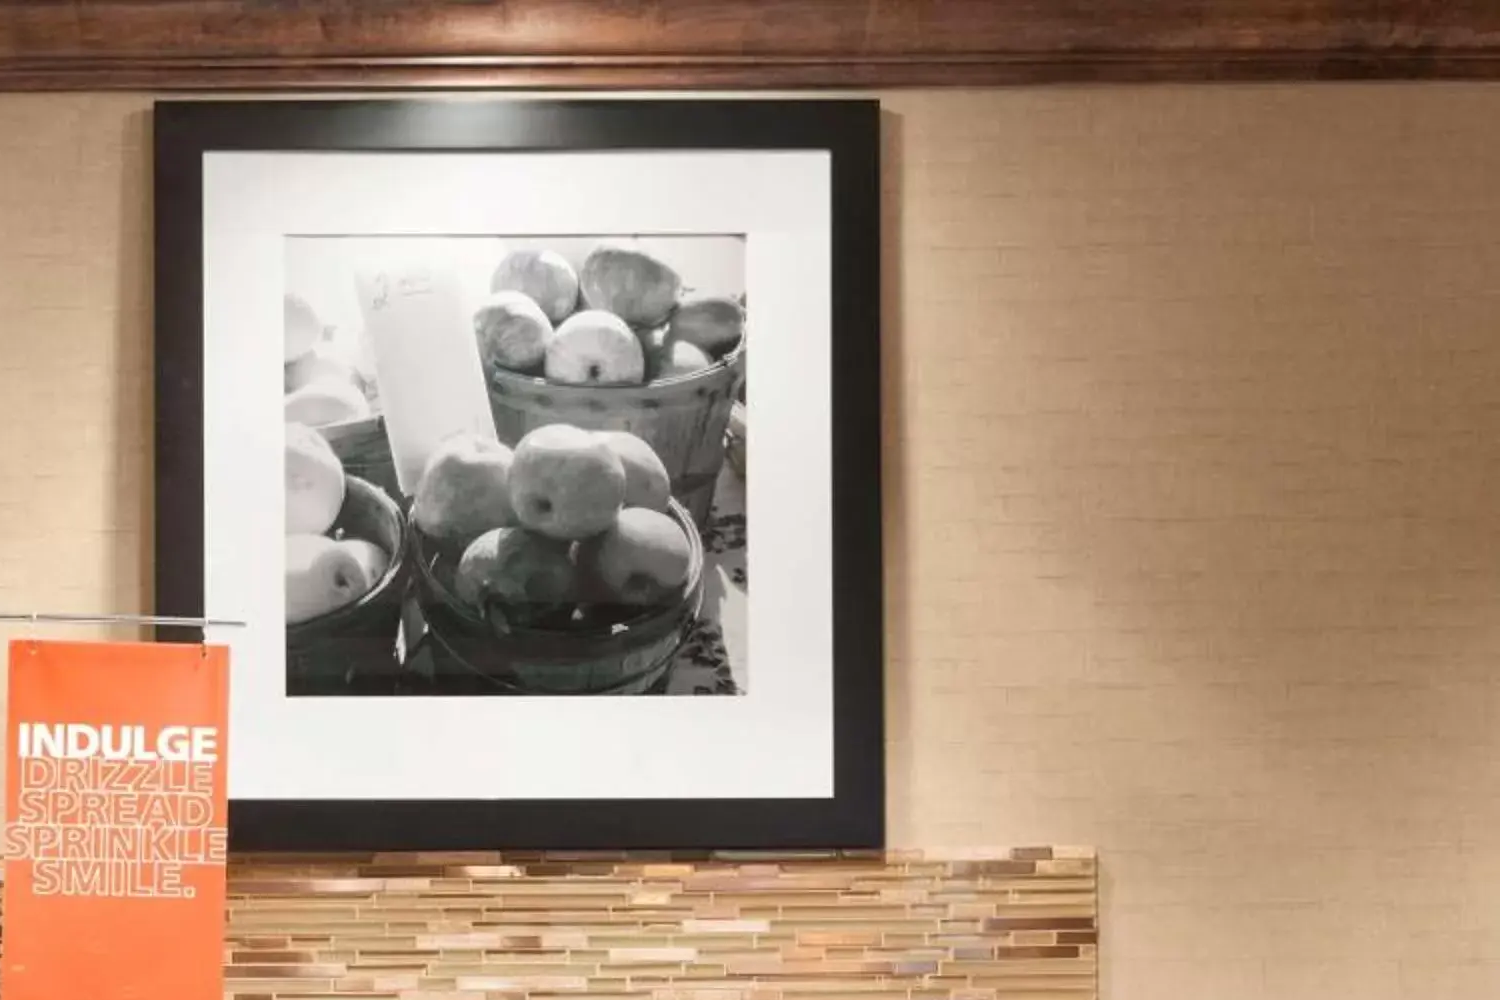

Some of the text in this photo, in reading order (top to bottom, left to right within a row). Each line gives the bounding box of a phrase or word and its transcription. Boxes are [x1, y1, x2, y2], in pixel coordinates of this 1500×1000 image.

[18, 722, 218, 761] INDULGE
[21, 757, 213, 796] DRIZZLE
[19, 790, 214, 829] SPREAD
[4, 822, 228, 864] SPRINKLE
[33, 859, 196, 898] SMILE.
